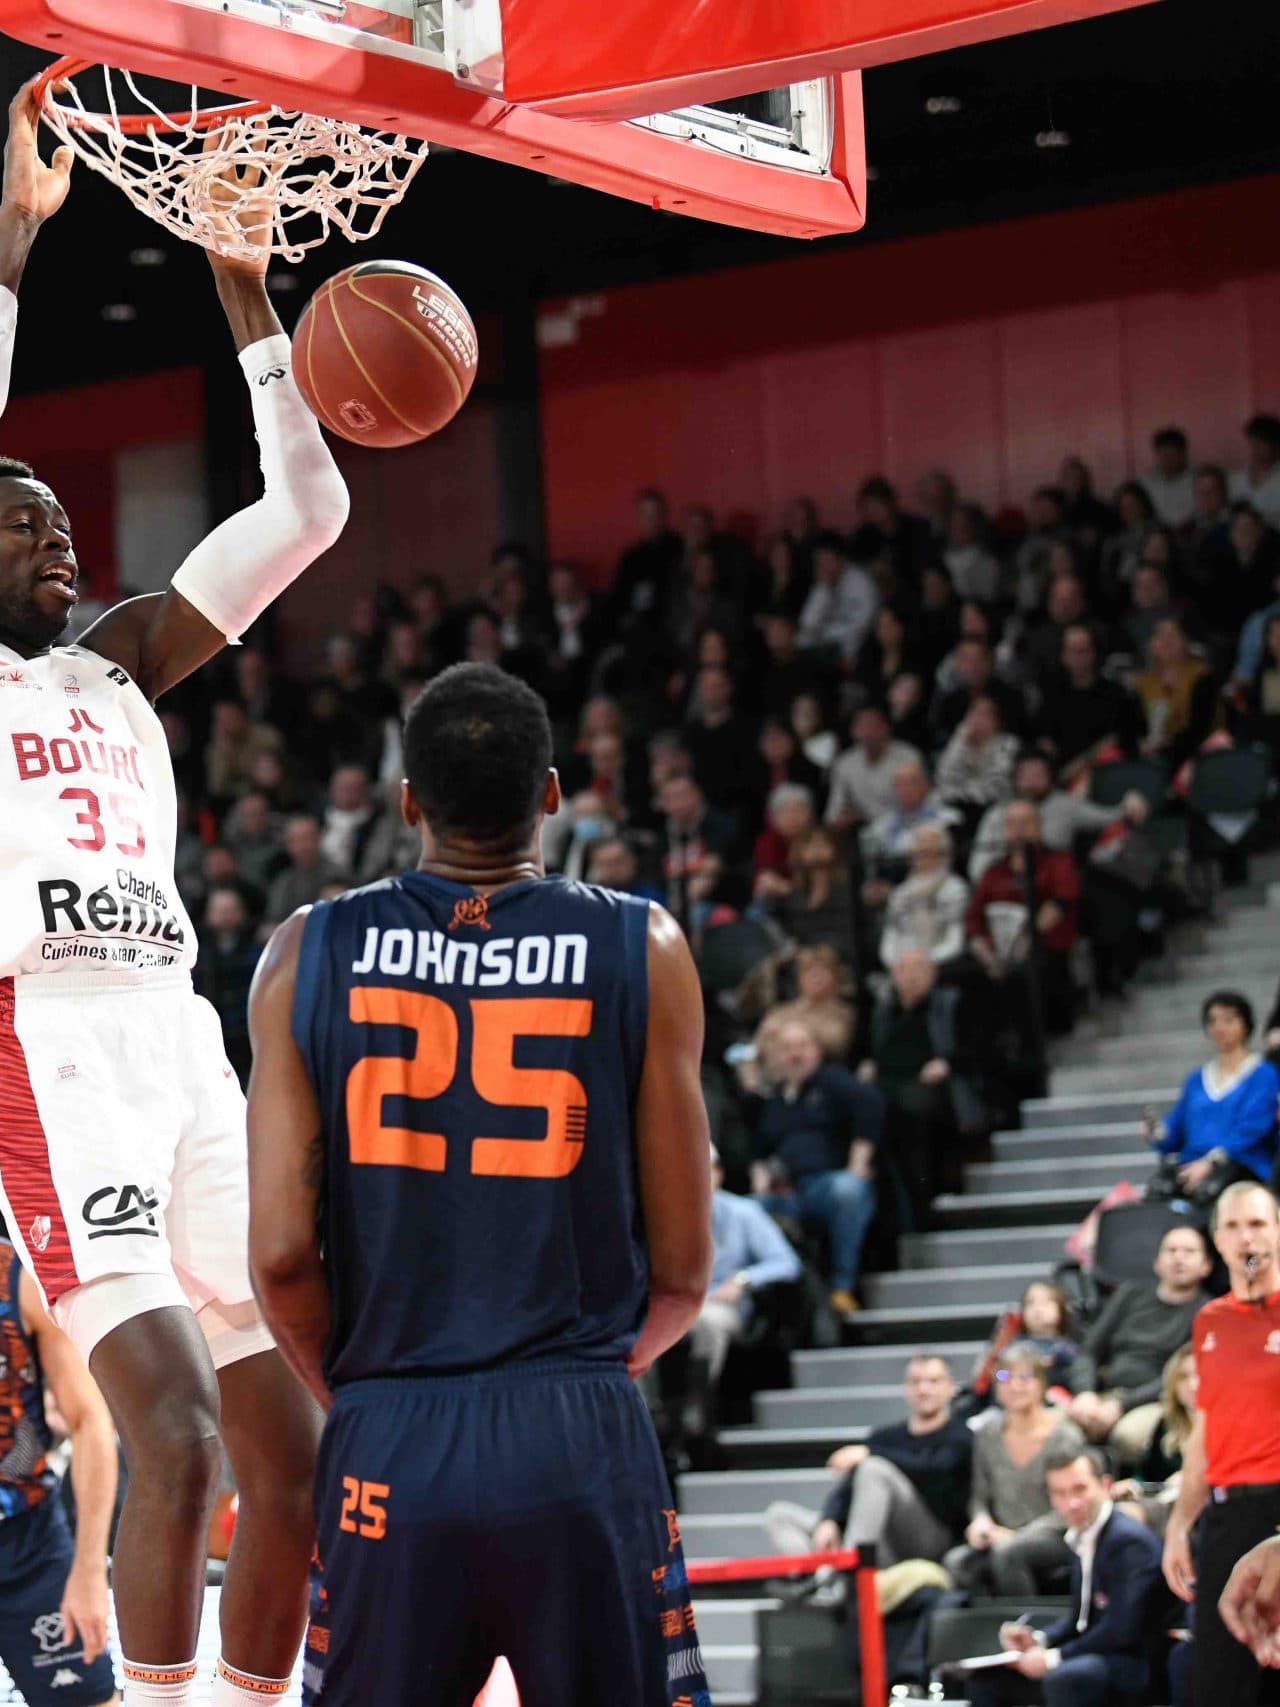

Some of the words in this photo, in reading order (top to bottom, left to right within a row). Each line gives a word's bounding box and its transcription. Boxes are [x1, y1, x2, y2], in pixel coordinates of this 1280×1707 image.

[116, 868, 168, 910] Charles
[41, 939, 108, 961] Cuisines
[352, 927, 588, 986] JOHNSON
[346, 986, 594, 1179] 25
[339, 1475, 390, 1541] 25
